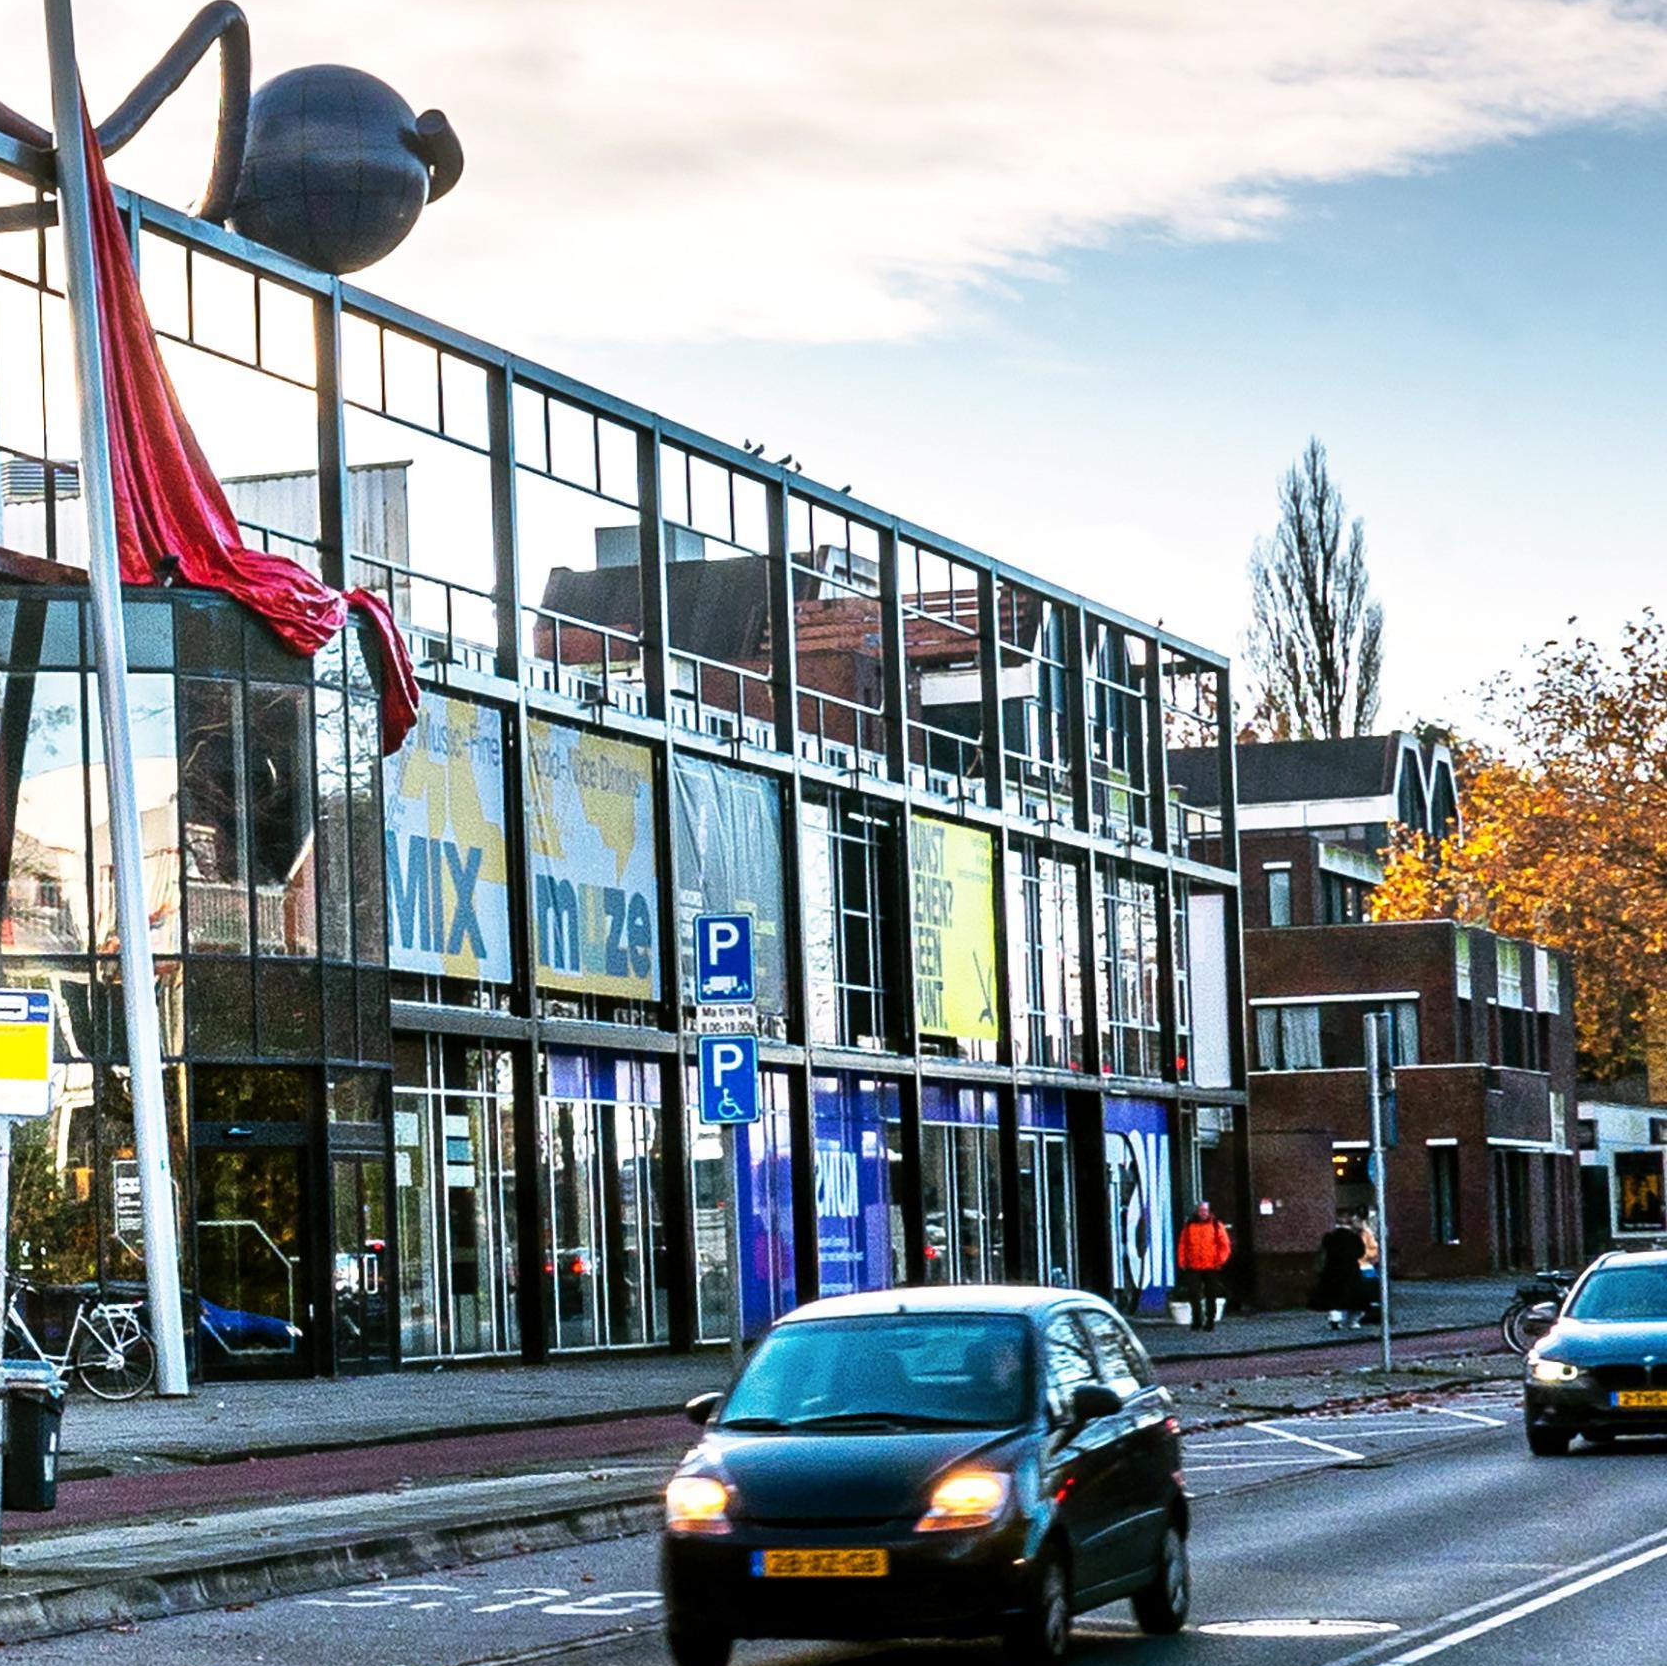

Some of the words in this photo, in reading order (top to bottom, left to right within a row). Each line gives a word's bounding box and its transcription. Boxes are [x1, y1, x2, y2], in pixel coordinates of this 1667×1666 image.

[385, 830, 487, 959] MIX
[535, 874, 652, 978] muze
[709, 923, 739, 966] P
[713, 1043, 744, 1087] P
